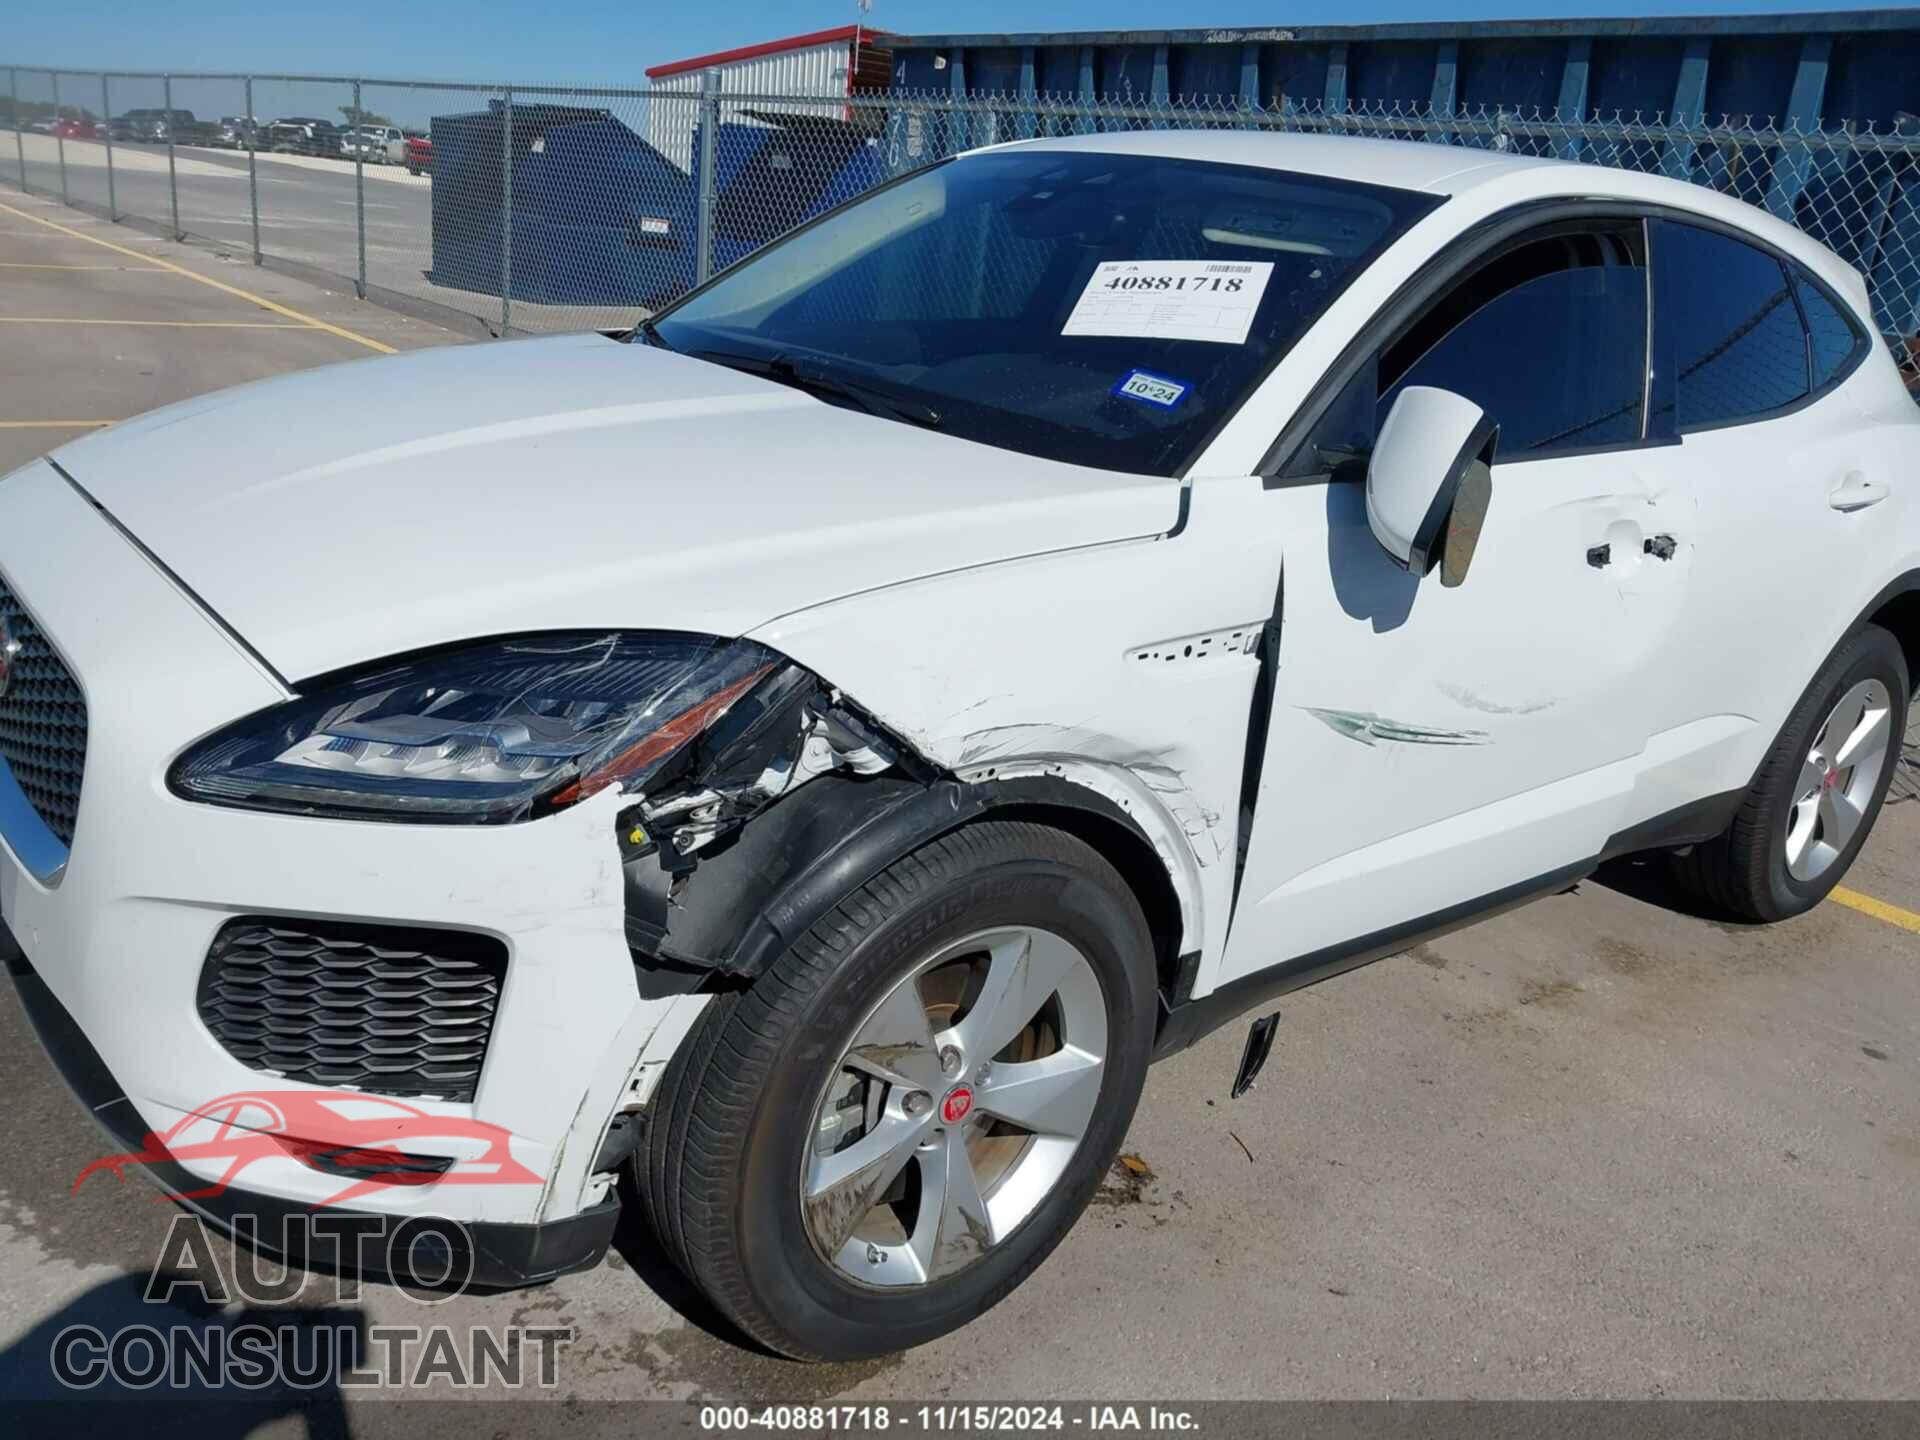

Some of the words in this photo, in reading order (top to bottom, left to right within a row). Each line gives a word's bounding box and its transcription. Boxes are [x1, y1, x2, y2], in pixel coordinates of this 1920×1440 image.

[1104, 276, 1244, 293] 40881718
[1128, 380, 1149, 394] 10
[1152, 388, 1176, 401] 24
